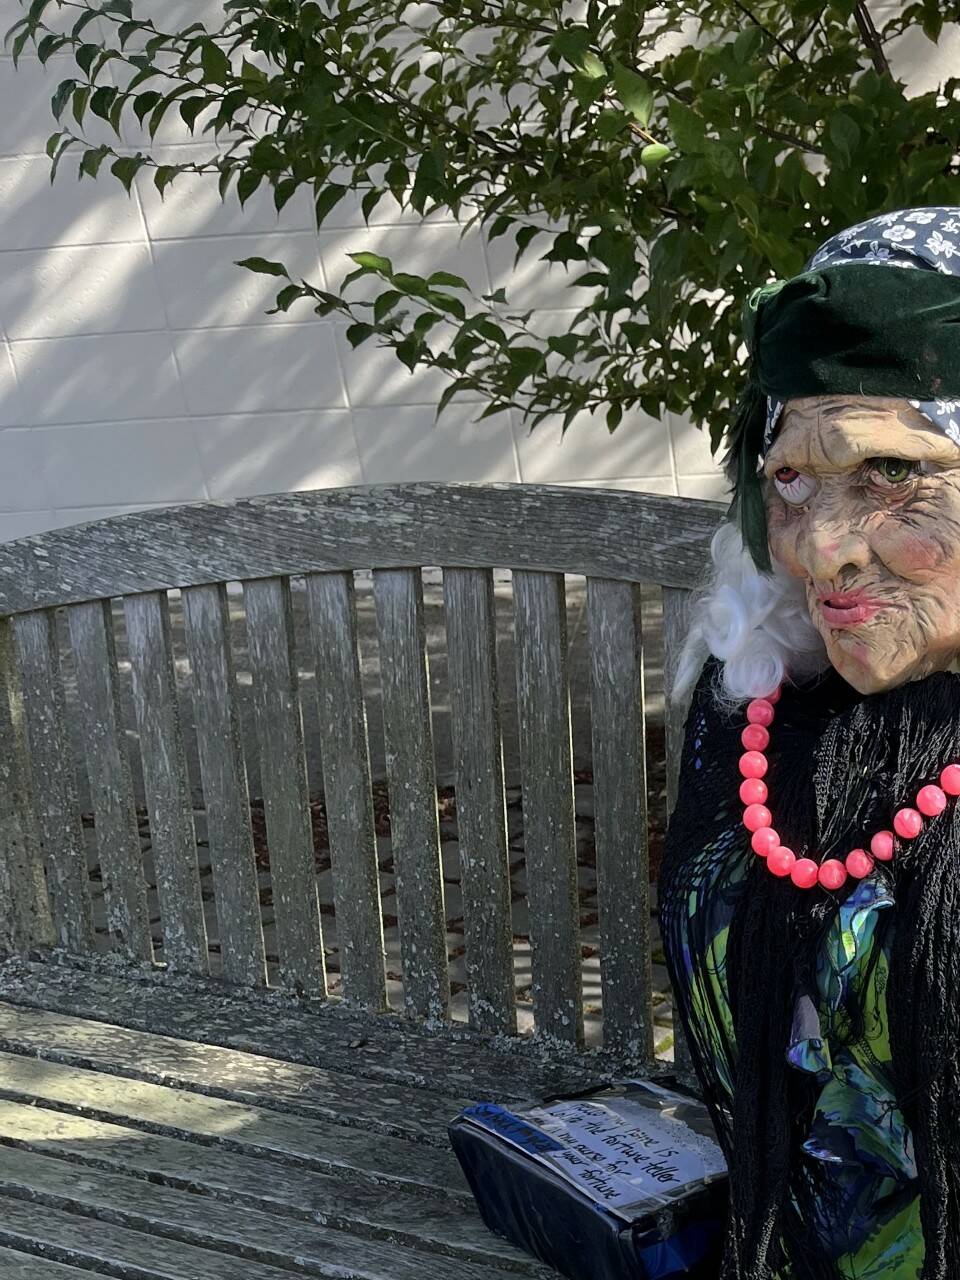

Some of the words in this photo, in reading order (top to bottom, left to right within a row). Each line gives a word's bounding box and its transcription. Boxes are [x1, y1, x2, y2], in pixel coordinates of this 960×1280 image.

[553, 1149, 588, 1166] your
[578, 1168, 621, 1200] fortune
[601, 1134, 650, 1164] fortune
[642, 1158, 680, 1183] teller
[607, 1159, 633, 1178] for
